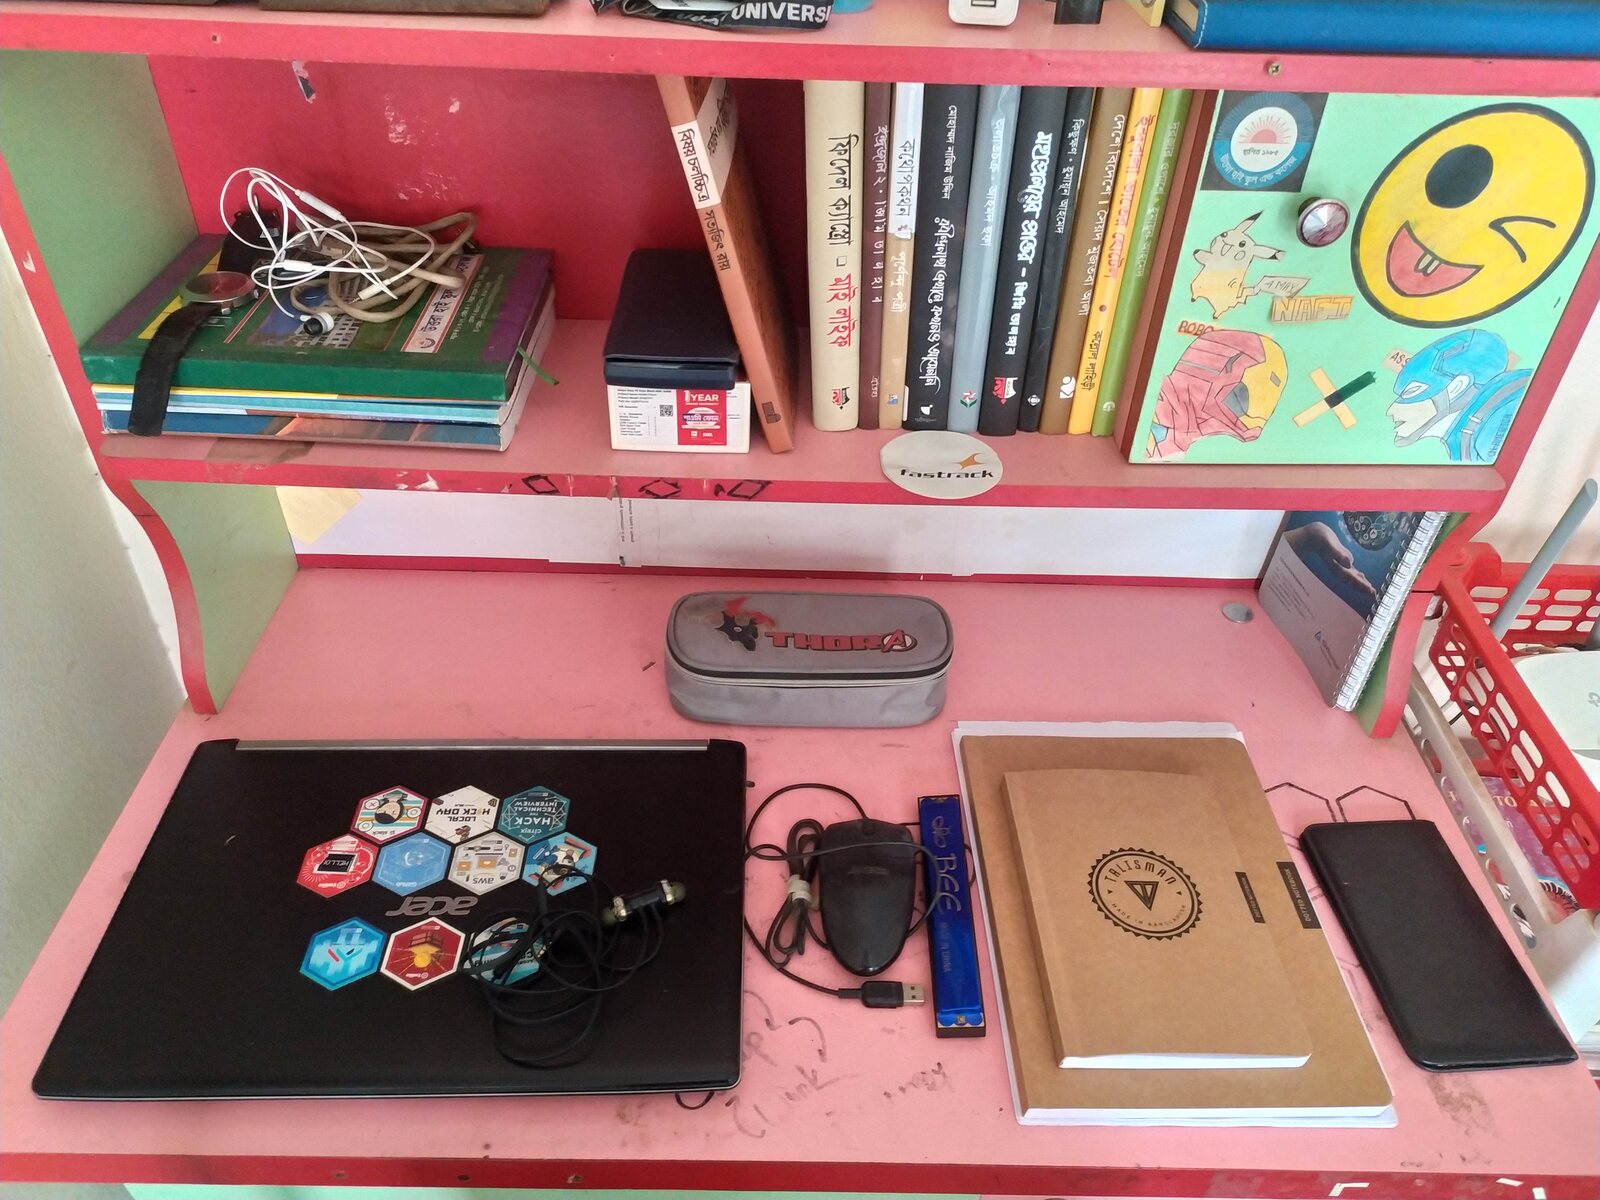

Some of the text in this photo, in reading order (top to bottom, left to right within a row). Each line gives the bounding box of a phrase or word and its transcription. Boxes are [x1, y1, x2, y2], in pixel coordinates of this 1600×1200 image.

[677, 129, 700, 158] বিষয়
[828, 133, 859, 189] ফিদেল
[943, 146, 956, 174] নাজিম
[895, 139, 916, 217] কথোপকথন
[1053, 199, 1071, 235] আহমেদ
[715, 250, 731, 272] রায়
[826, 273, 858, 303] মাই
[827, 306, 858, 348] লাইফ
[690, 393, 719, 402] YEAR
[899, 468, 995, 479] fastrack
[435, 808, 460, 816] DAY
[514, 816, 551, 825] HACK
[471, 877, 495, 885] aws
[1104, 858, 1177, 886] TALISMAN
[385, 896, 479, 916] acer
